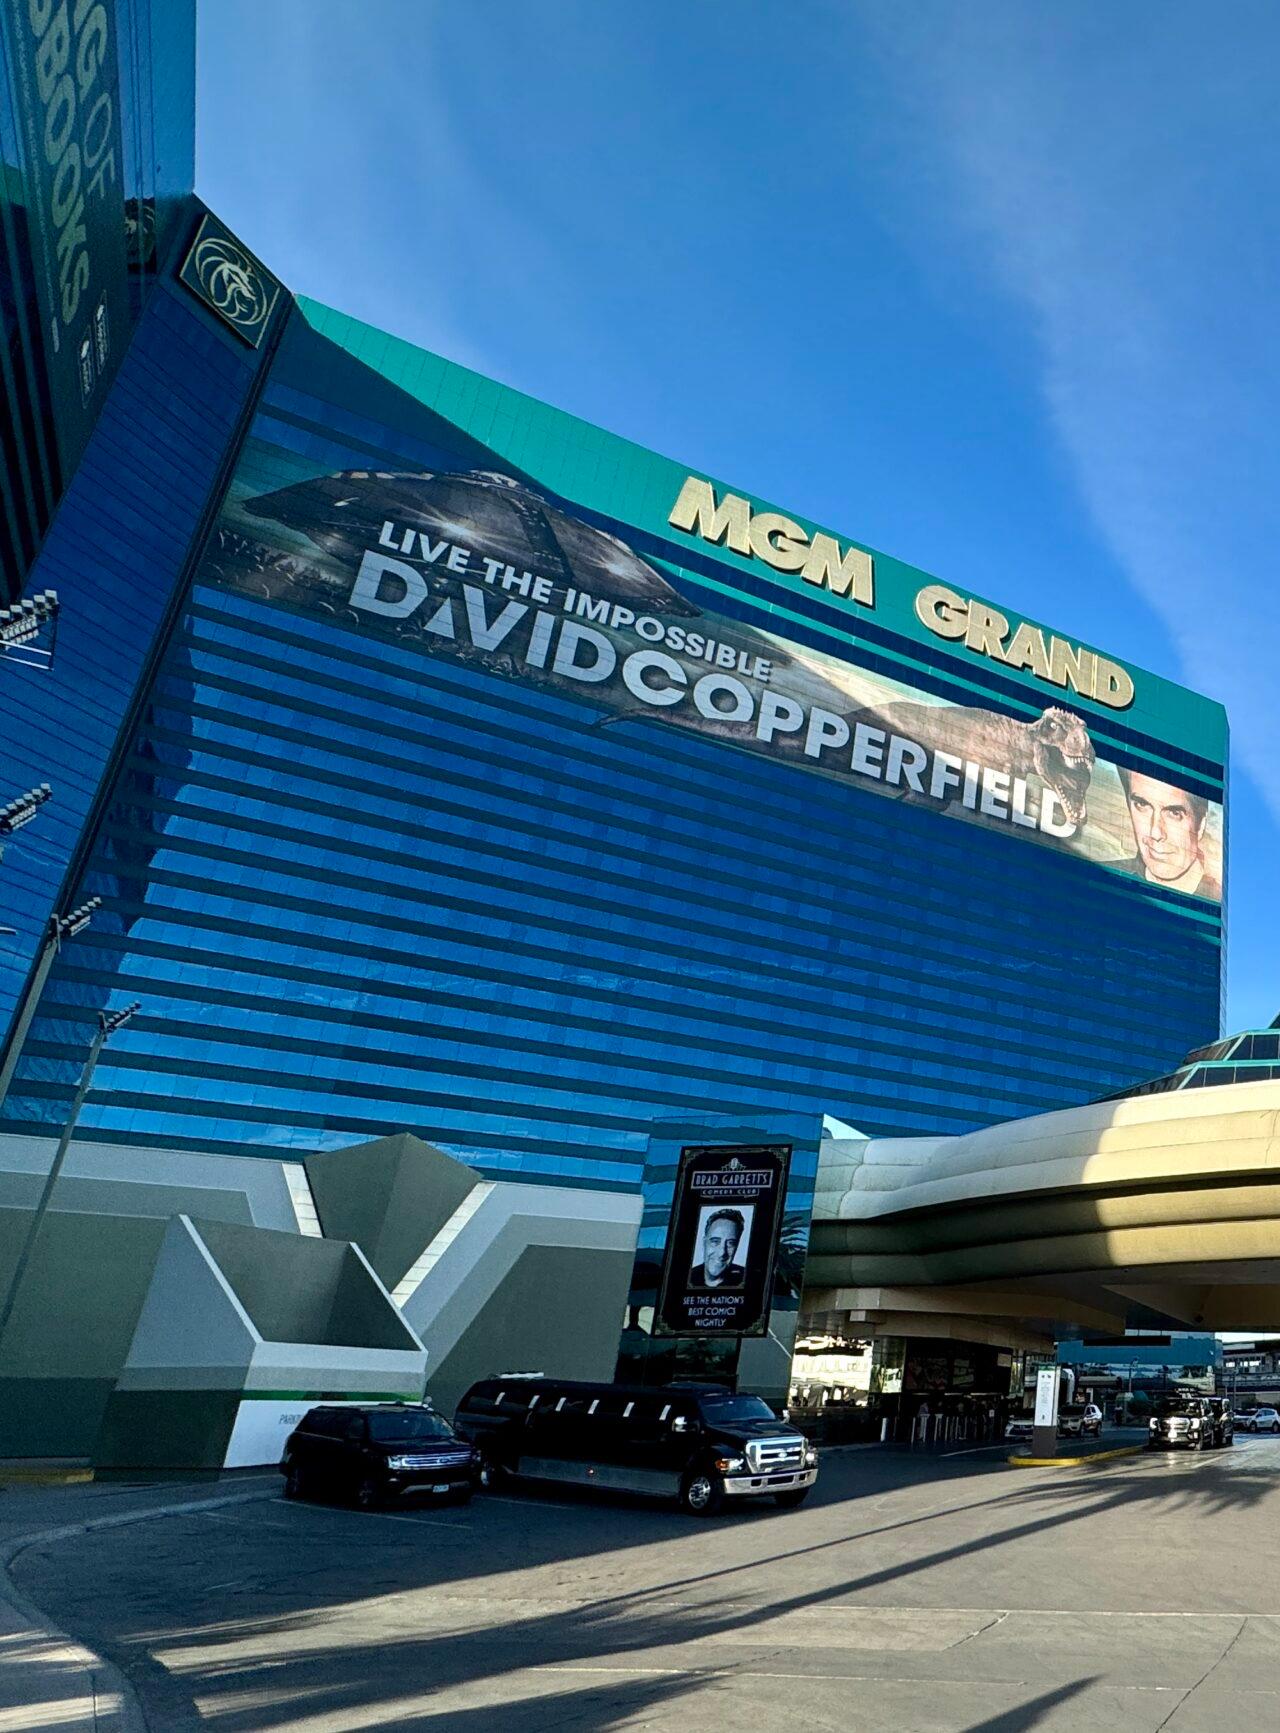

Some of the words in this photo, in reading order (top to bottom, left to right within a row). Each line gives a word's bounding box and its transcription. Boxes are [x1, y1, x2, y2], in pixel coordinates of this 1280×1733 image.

[84, 93, 116, 200] OF
[378, 520, 470, 575] LIVE
[482, 551, 553, 602] THE
[563, 588, 774, 683] IMPOSSIBLE
[668, 476, 874, 607] MGM
[914, 585, 1135, 708] GRAND
[348, 549, 617, 684] DAVID
[622, 649, 1078, 838] COPPERFIELD
[695, 1174, 718, 1185] BRAD
[721, 1173, 768, 1184] GARRETT'S
[682, 1296, 695, 1305] SEE
[697, 1296, 710, 1305] THE
[711, 1295, 745, 1305] NATION'S
[688, 1307, 704, 1316] BEST
[705, 1307, 736, 1316] COMICS
[694, 1318, 727, 1328] NIGHTLY
